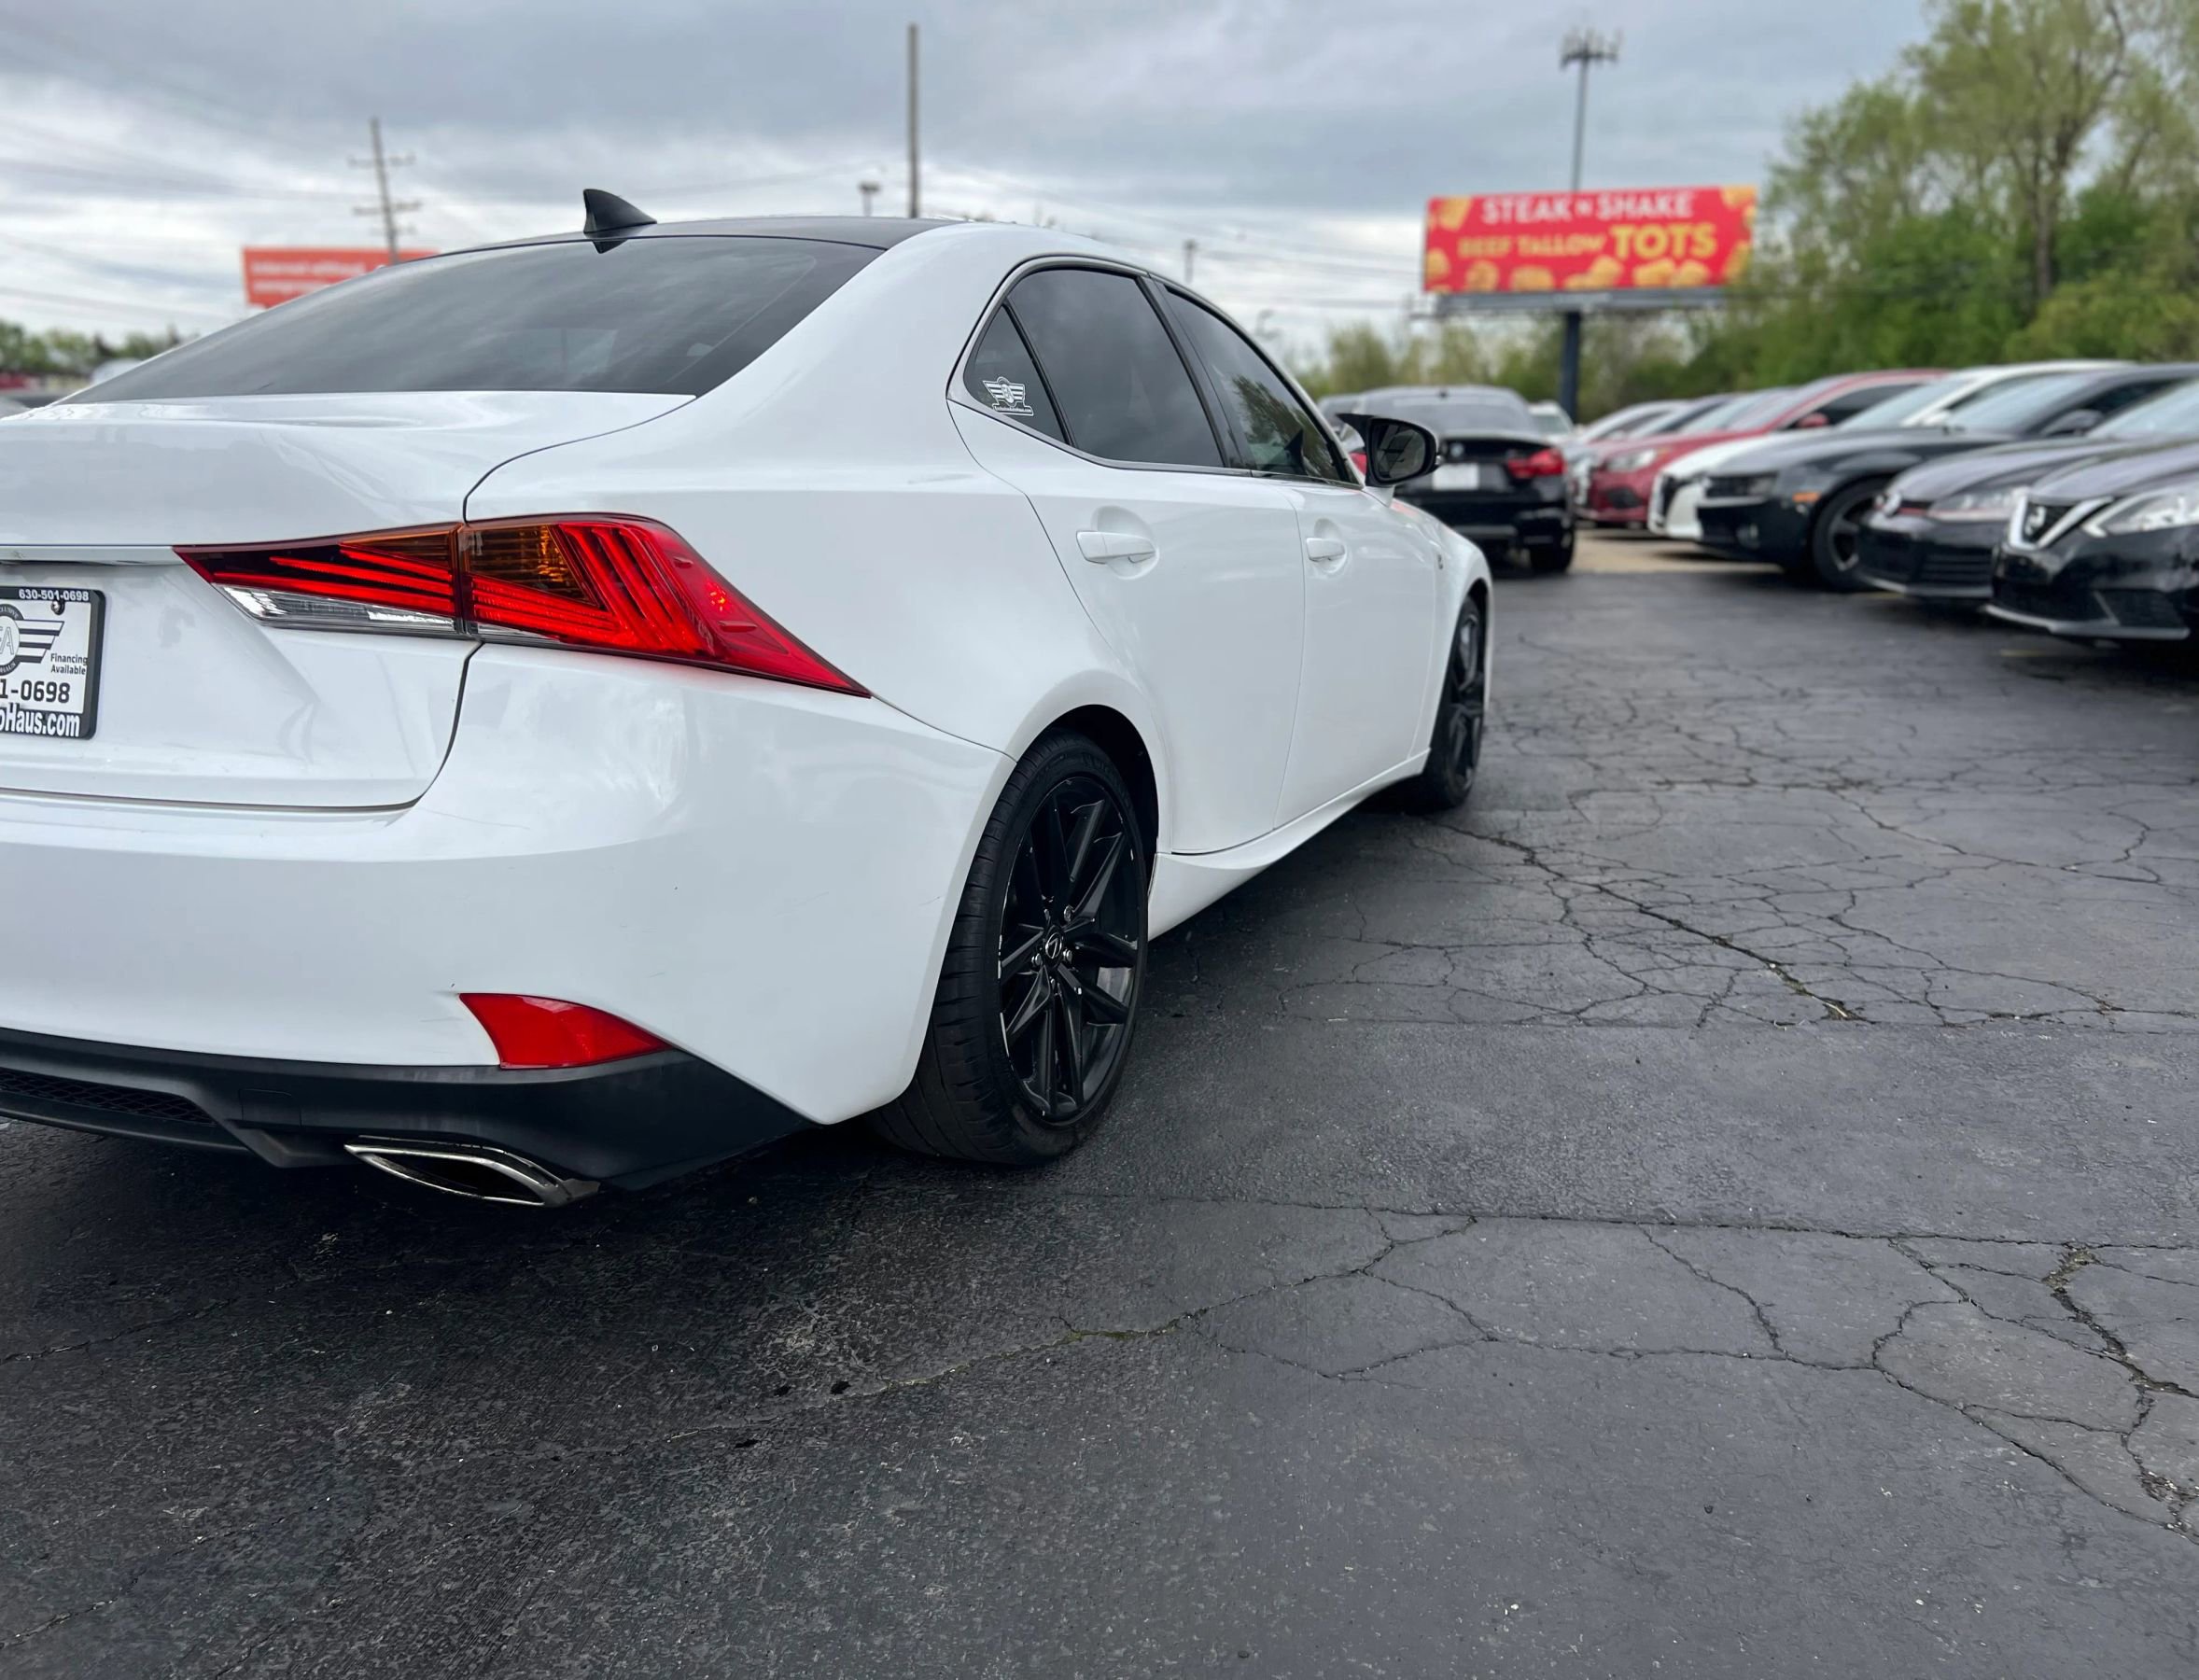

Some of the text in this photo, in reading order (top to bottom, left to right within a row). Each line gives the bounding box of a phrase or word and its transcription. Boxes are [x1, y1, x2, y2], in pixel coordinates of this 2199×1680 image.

[1481, 194, 1574, 225] STEAK
[1595, 189, 1694, 220] SHAKE
[1610, 222, 1717, 259] TOTS
[19, 589, 90, 601] 630-501-0698
[50, 652, 88, 665] Financing
[50, 665, 87, 676] Available
